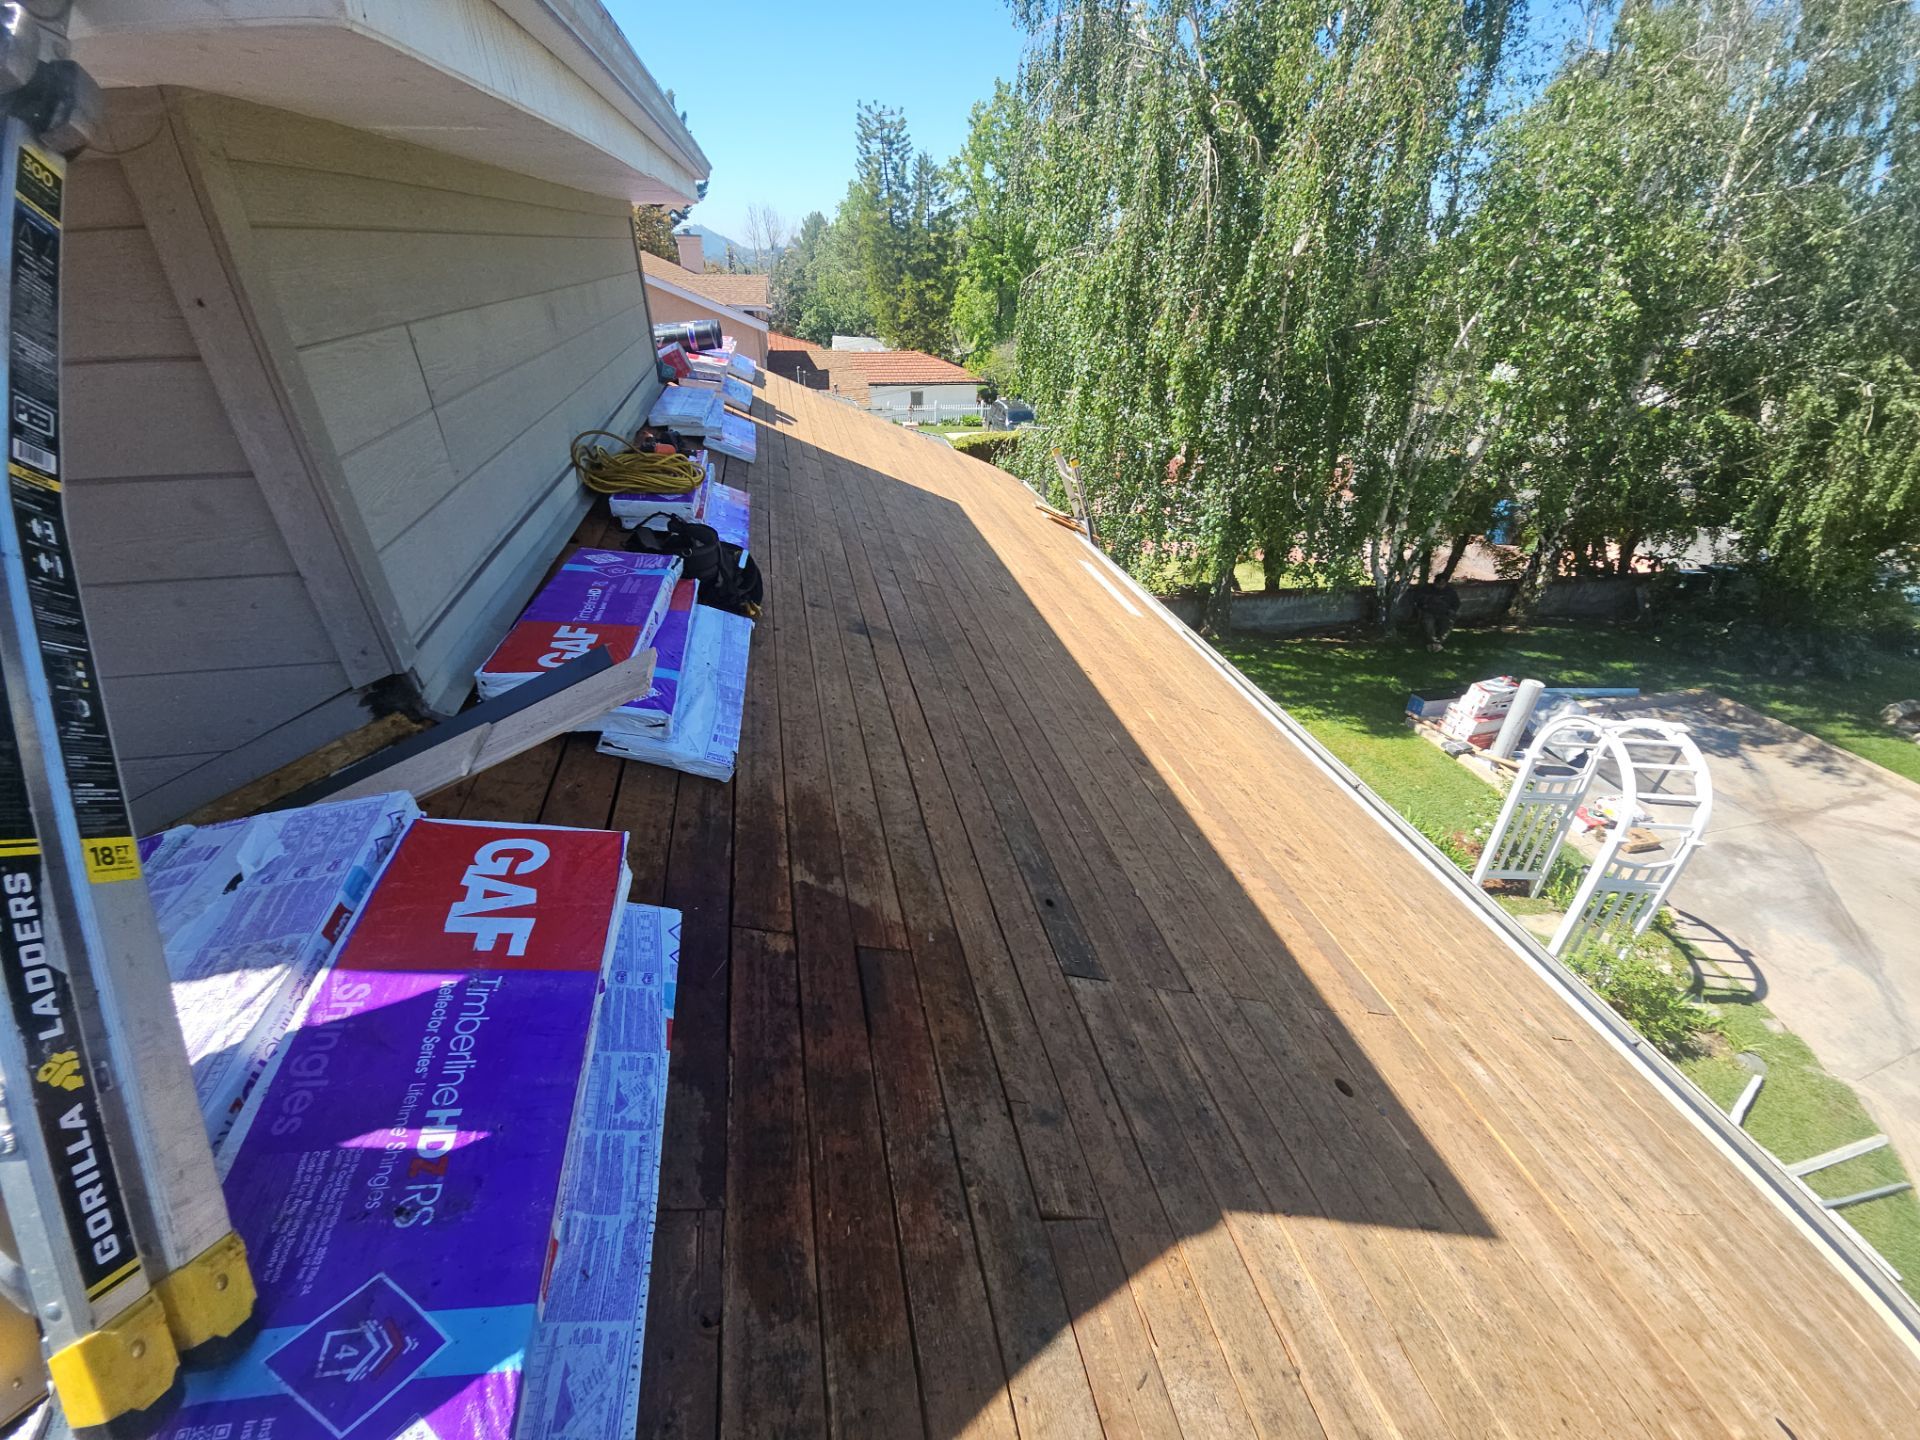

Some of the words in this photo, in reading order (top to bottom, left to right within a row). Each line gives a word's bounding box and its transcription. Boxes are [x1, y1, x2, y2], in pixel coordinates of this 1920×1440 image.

[23, 153, 54, 188] 300
[538, 625, 600, 668] GAF
[89, 846, 115, 867] 18
[115, 845, 130, 855] FT
[444, 838, 552, 957] GAF
[3, 872, 65, 1041] LADDERS
[424, 980, 459, 1033] Reflector
[268, 982, 374, 1136] Shingles
[59, 1102, 121, 1265] GORILLA
[332, 1169, 348, 1186] Cool
[362, 1141, 407, 1210] Shingles
[265, 1234, 288, 1269] County
[311, 1246, 328, 1265] 2022
